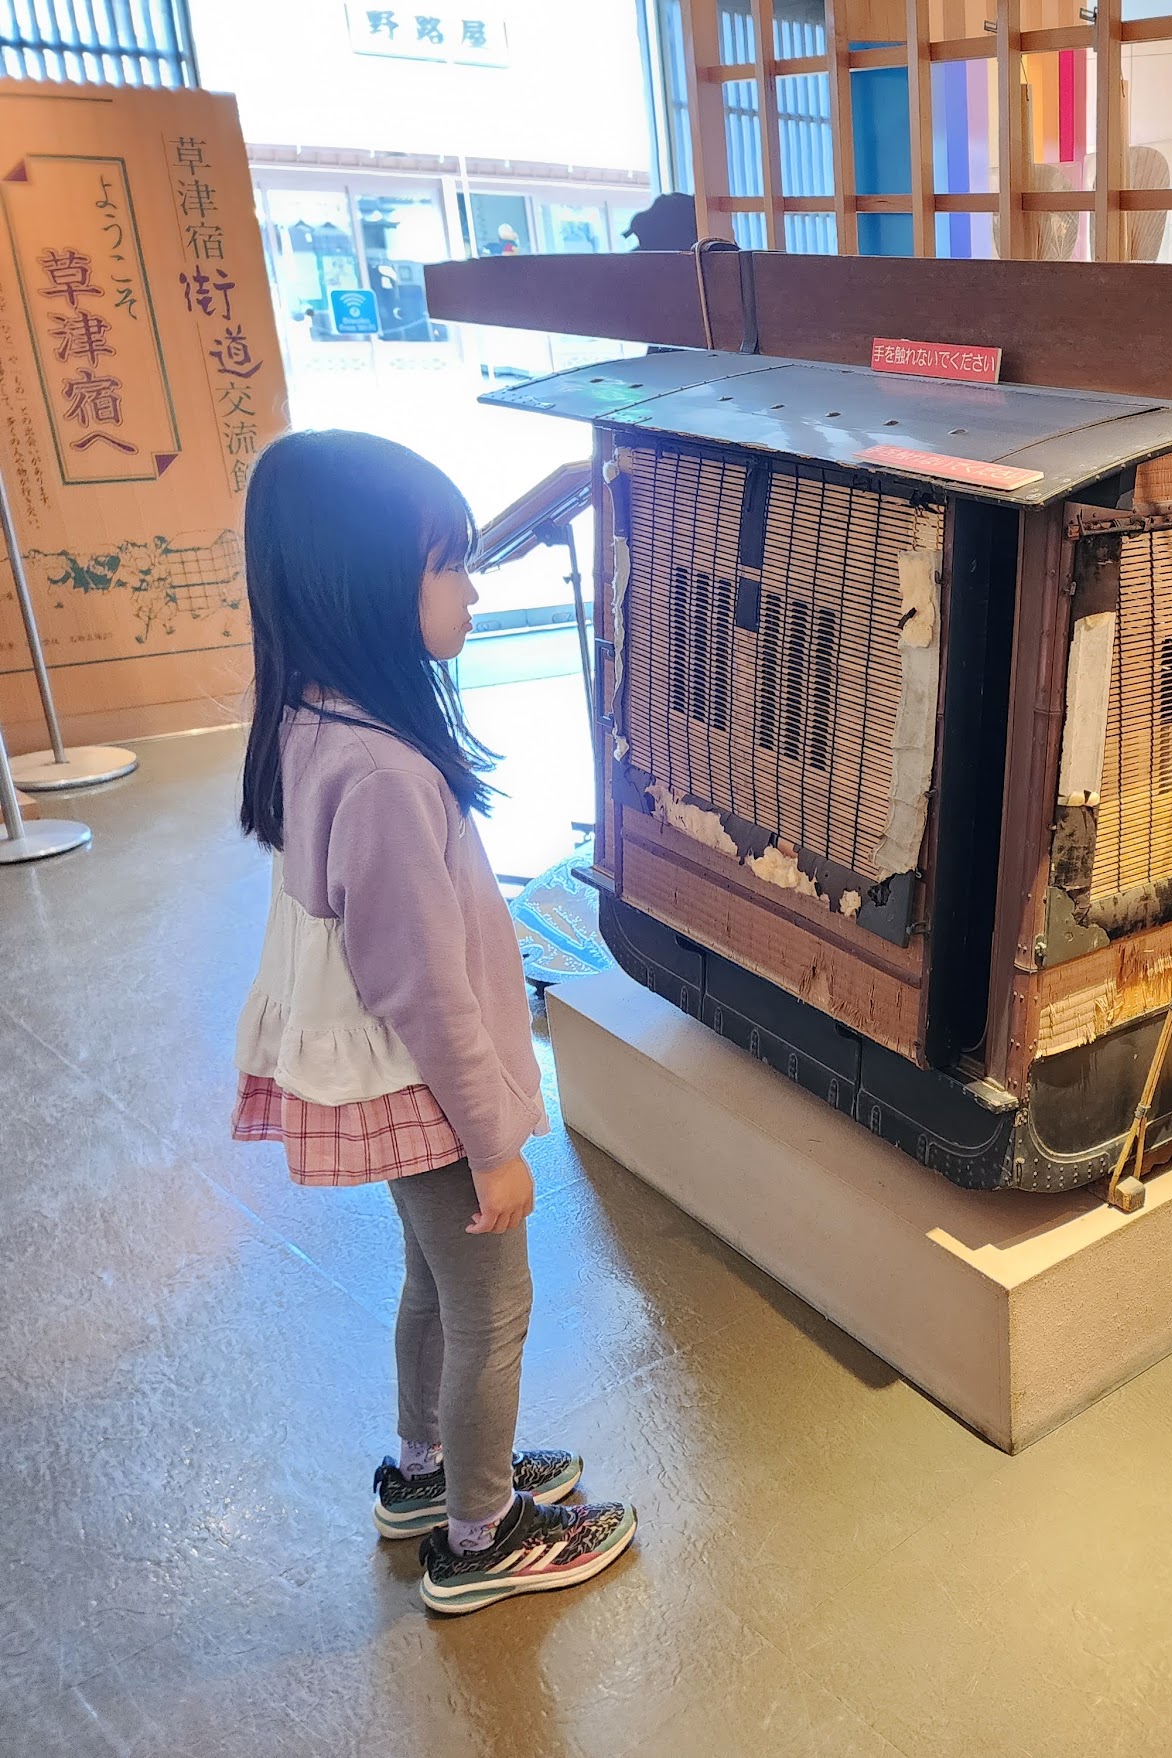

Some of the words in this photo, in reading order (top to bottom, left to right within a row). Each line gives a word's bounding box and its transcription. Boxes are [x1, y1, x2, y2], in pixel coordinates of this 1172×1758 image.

[366, 10, 488, 49] 野路屋
[96, 175, 137, 320] ようこそ
[38, 248, 139, 455] 草津宿へ
[873, 344, 996, 373] 手を触れないでください
